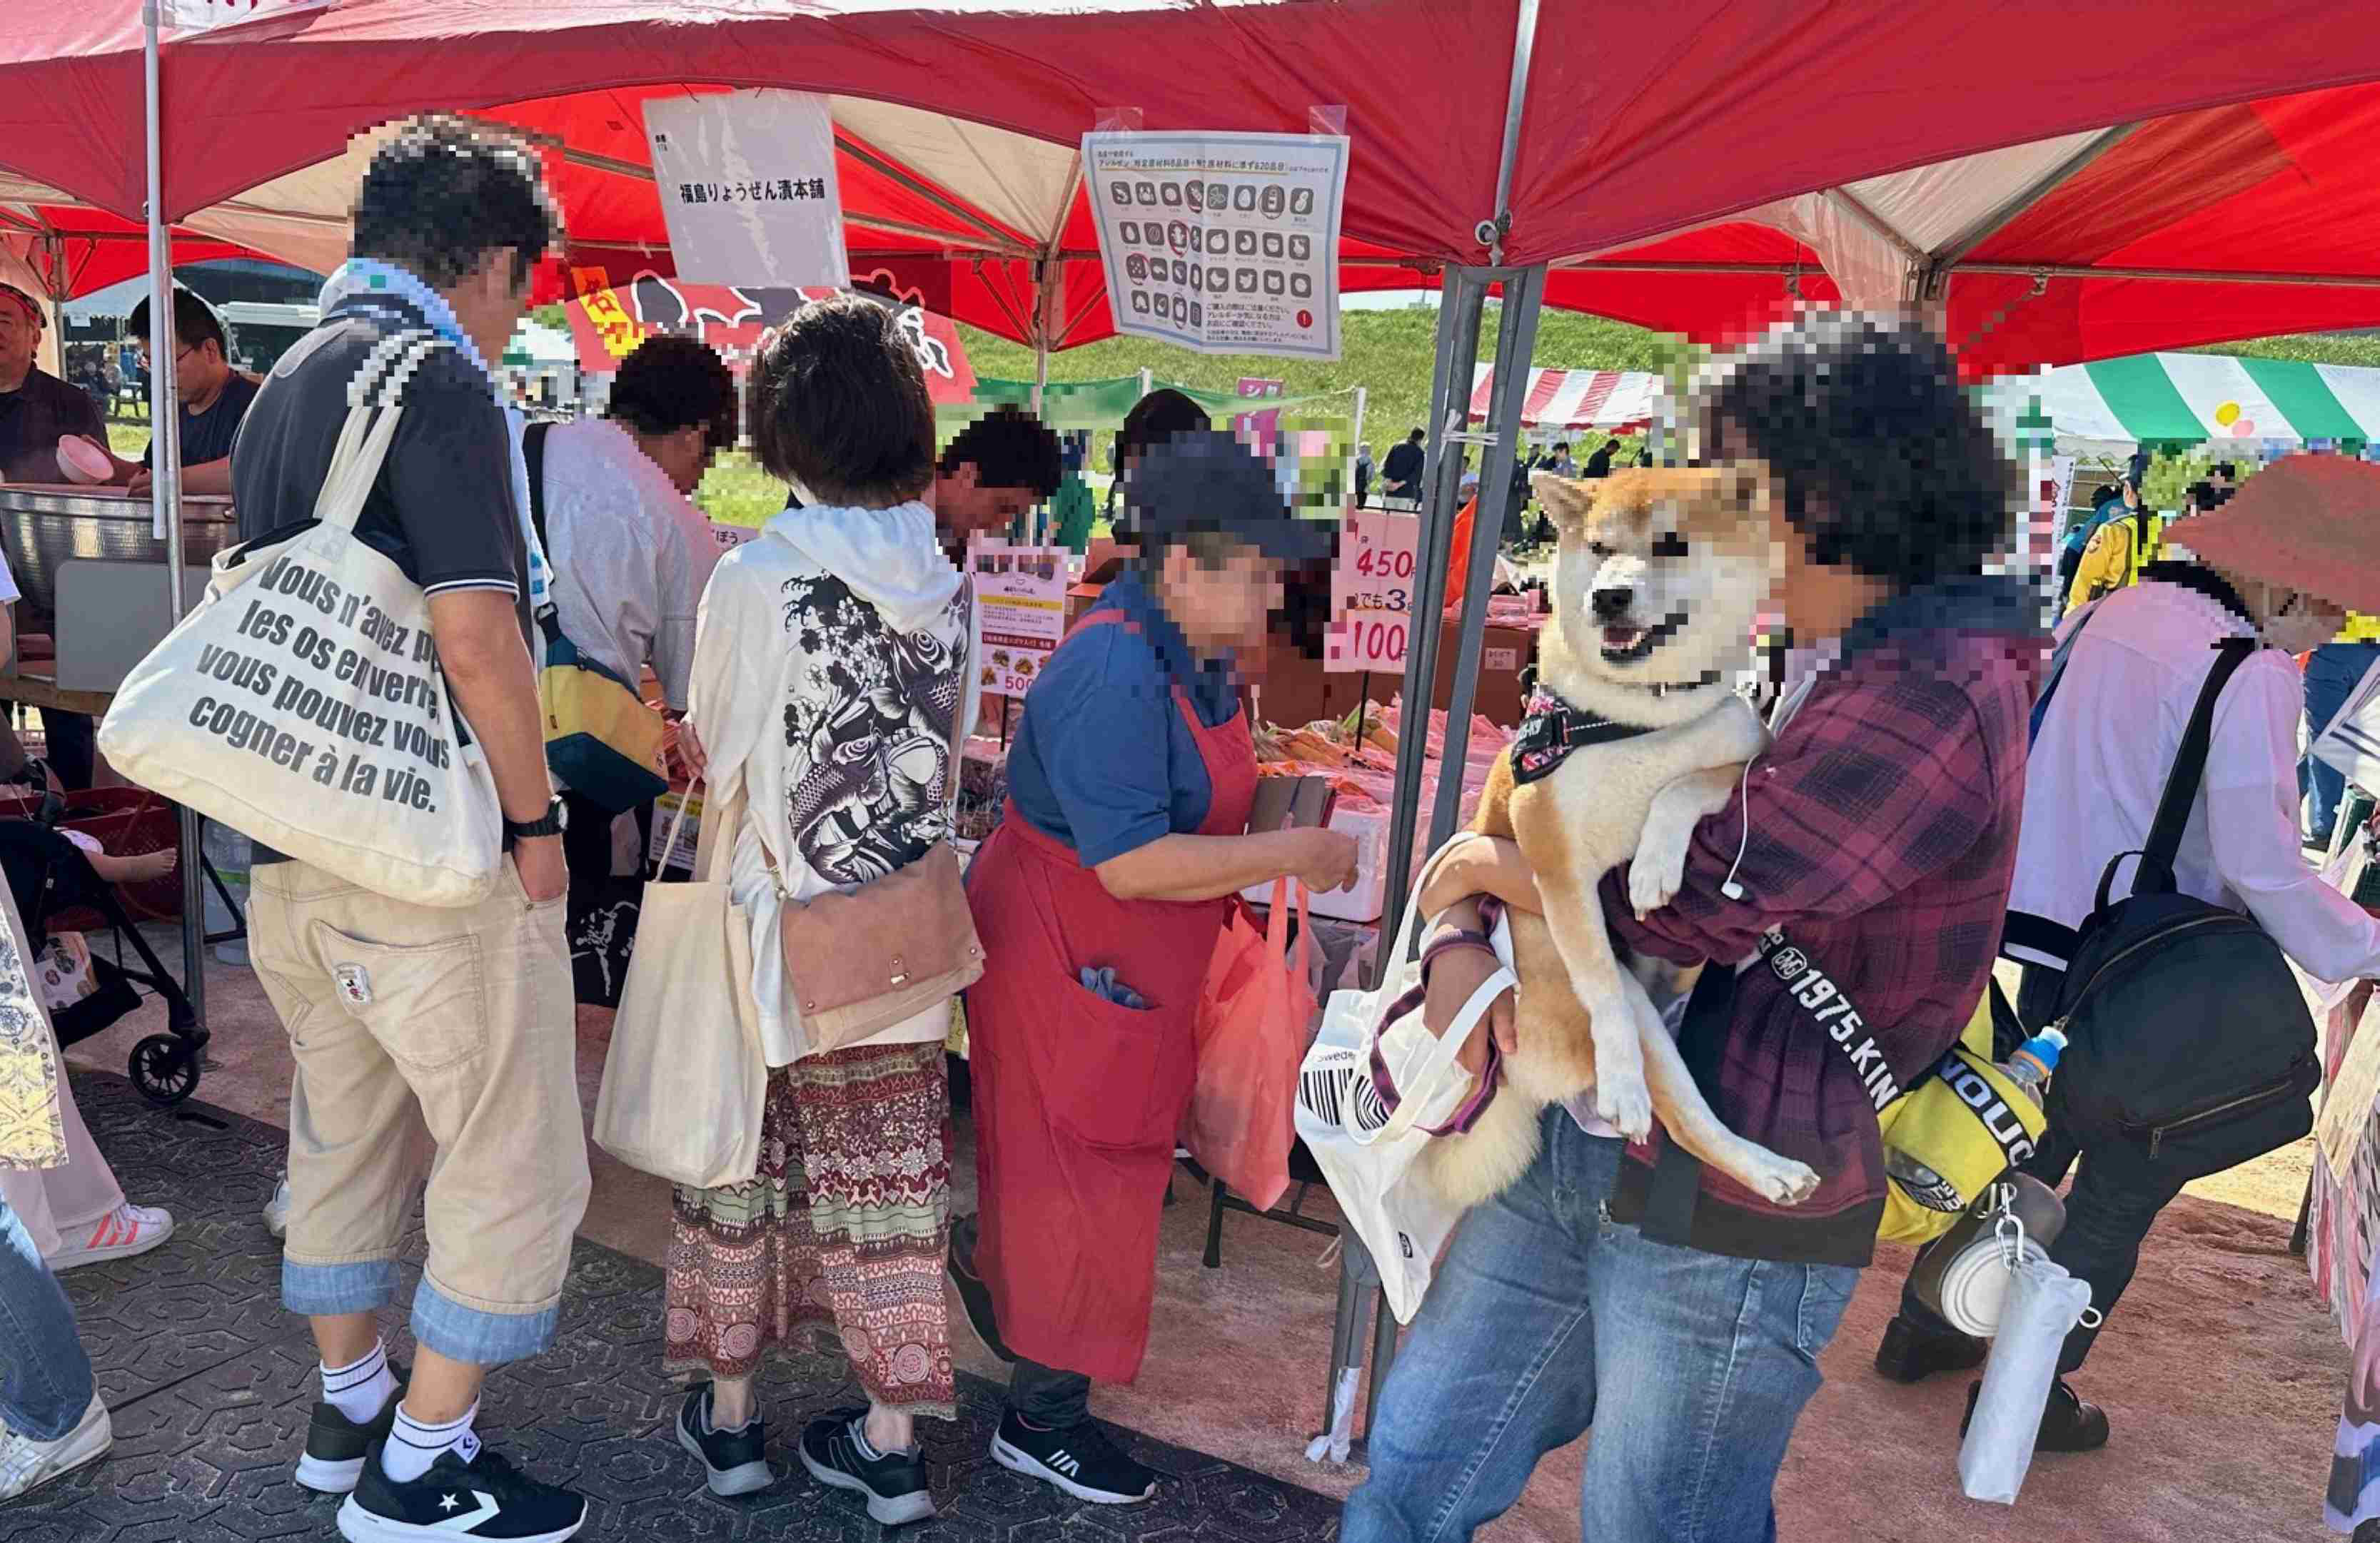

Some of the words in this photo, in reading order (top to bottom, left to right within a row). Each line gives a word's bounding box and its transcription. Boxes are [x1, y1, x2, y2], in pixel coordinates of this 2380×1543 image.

[680, 178, 825, 204] 福島りょうぜん漬本舗
[712, 530, 738, 545] ぼう
[1355, 588, 1413, 612] でも3
[237, 599, 294, 645] les
[292, 626, 336, 669] os
[412, 629, 441, 672] p
[1353, 620, 1408, 662] 100
[196, 643, 277, 695] vous
[272, 674, 388, 747] pouvez
[393, 720, 450, 770] vous
[189, 696, 314, 774] cogner
[312, 744, 339, 786] à
[339, 754, 378, 796] la
[383, 767, 437, 814] vie.
